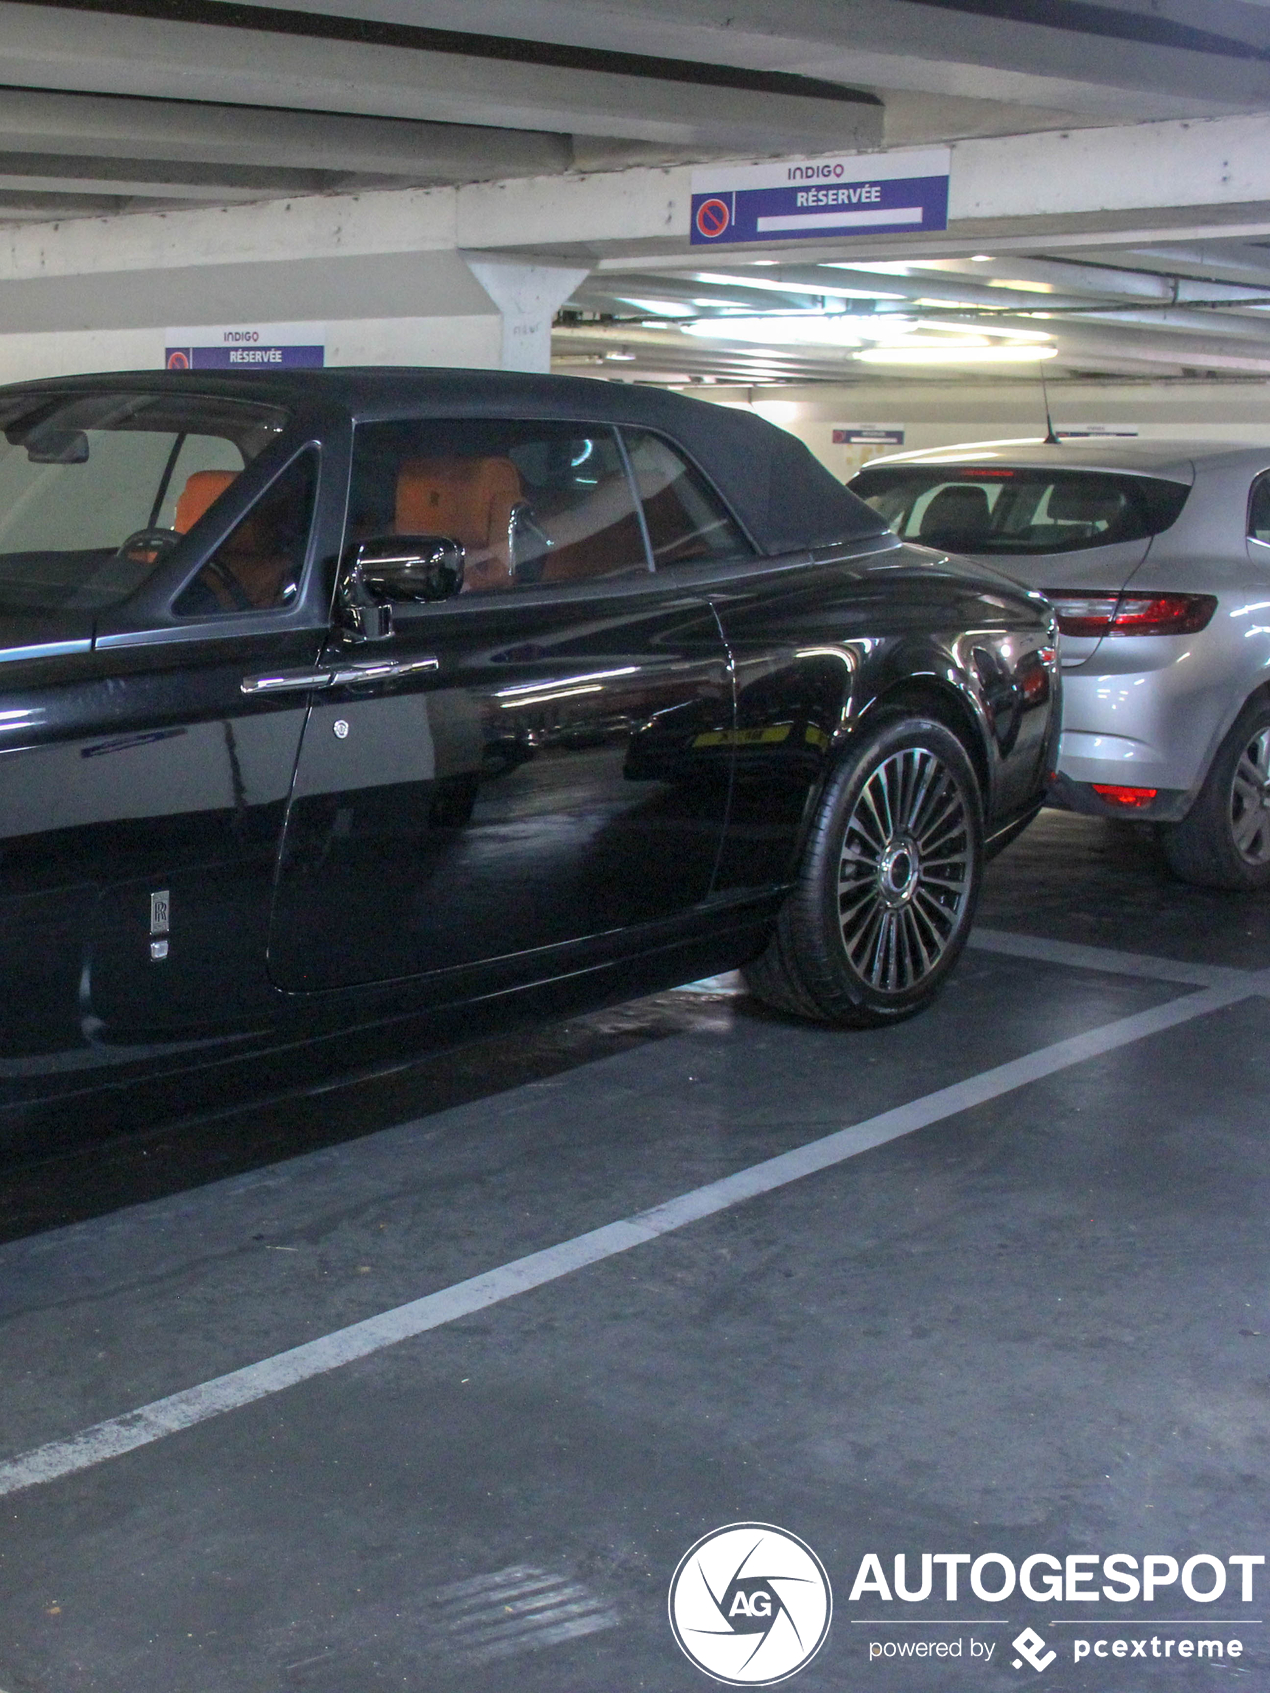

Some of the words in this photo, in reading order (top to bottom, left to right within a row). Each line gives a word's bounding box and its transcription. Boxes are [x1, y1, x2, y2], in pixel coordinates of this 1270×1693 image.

[787, 163, 845, 181] INDIGO
[796, 184, 882, 208] RÉSERVÉE
[223, 331, 260, 343] INDIGO
[229, 349, 283, 363] RÉSERVÉE
